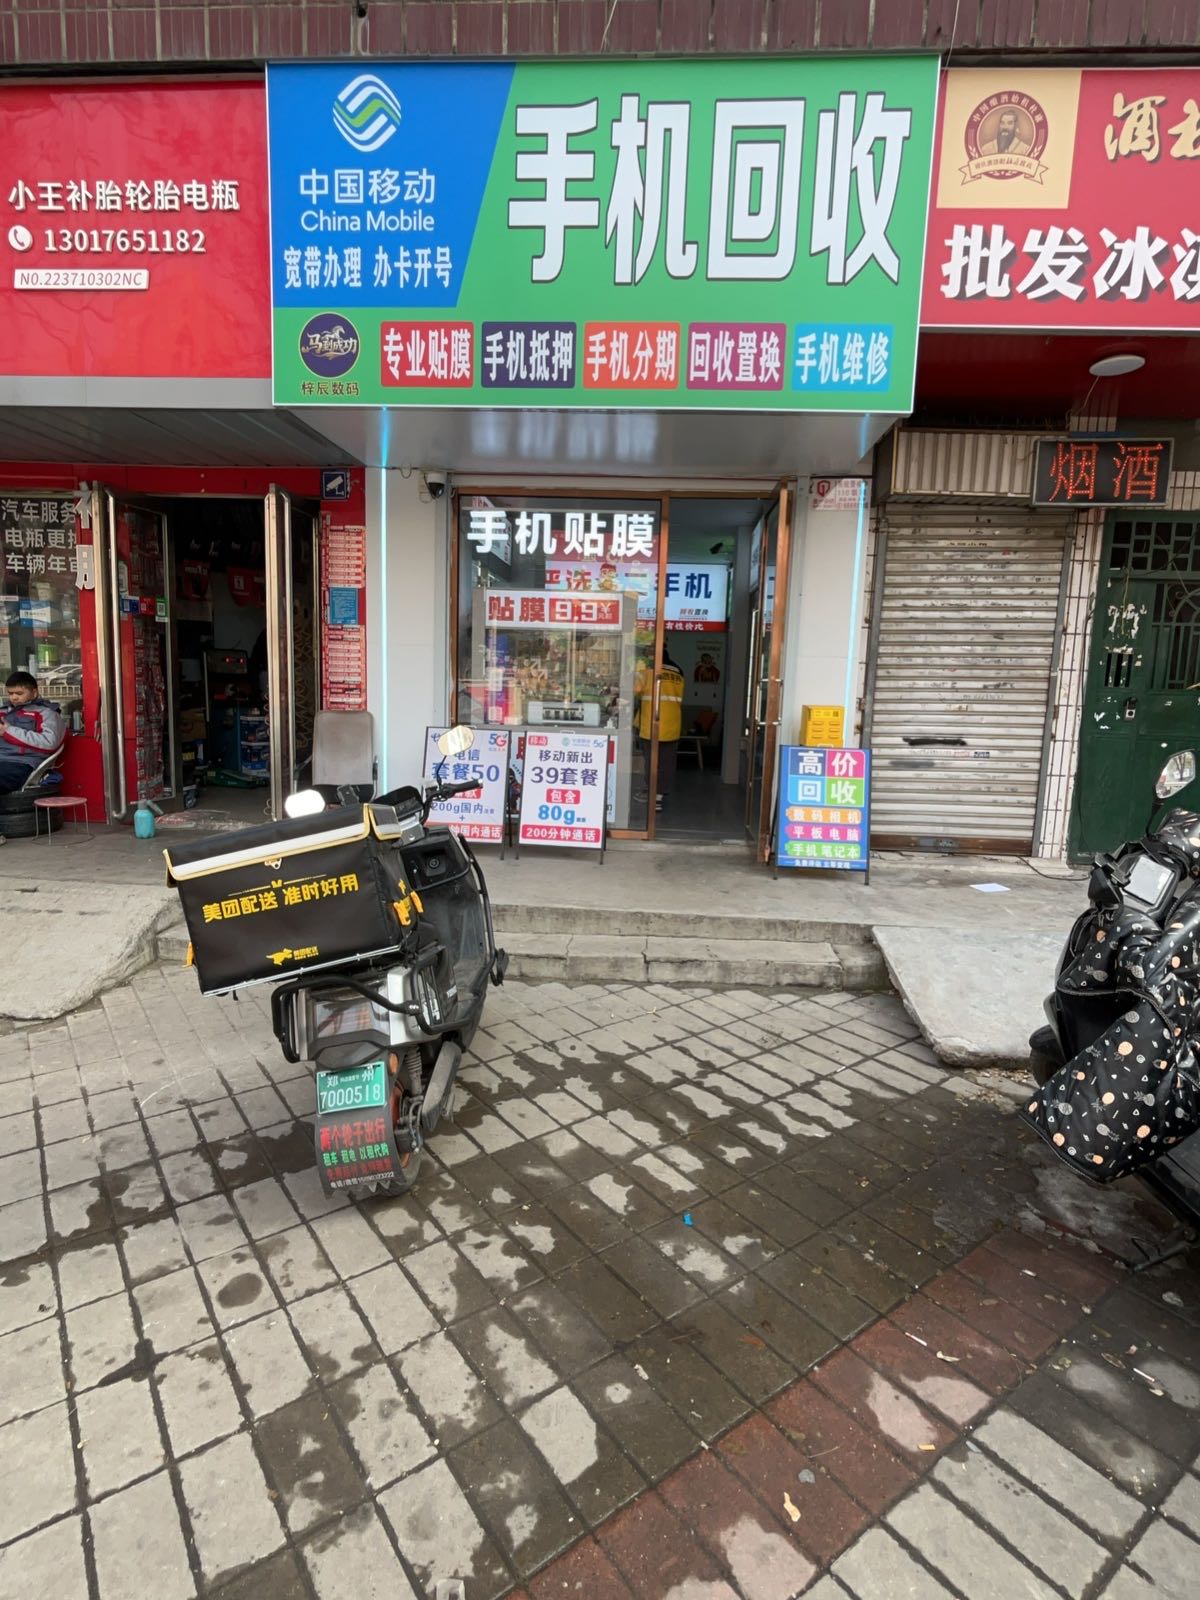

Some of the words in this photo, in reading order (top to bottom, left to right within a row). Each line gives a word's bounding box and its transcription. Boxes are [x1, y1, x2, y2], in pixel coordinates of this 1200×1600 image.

[7, 179, 241, 213] 小王补胎轮胎电瓶
[299, 167, 436, 206] 中国移动
[507, 91, 913, 287] 手机回收
[300, 210, 361, 232] China
[366, 209, 435, 232] Mobile
[44, 228, 207, 254] 13017651182
[19, 271, 143, 287] NO.223710302NC
[283, 245, 363, 290] 宽带办理
[373, 245, 453, 289] 办卡开号
[301, 330, 358, 355] 马到成功
[383, 327, 472, 381] 专业贴膜
[484, 329, 574, 382] 手机抵押
[586, 330, 678, 383] 手机分期
[689, 330, 782, 384] 回收置换
[795, 331, 890, 385] 手机维修
[301, 381, 360, 396] 梓辰数码
[1048, 441, 1164, 502] 烟酒
[1, 498, 76, 524] 汽车服务
[467, 509, 655, 558] 手机贴膜
[488, 595, 545, 623] 贴膜
[489, 733, 508, 748] 5G
[539, 749, 593, 764] 移动新出
[798, 750, 858, 777] 高价
[431, 762, 500, 782] 套餐50
[530, 766, 599, 787] 39套餐
[550, 790, 576, 804] 包含
[798, 780, 857, 804] 回收
[537, 804, 576, 826] 80g
[525, 827, 597, 841] 200分钟通话
[792, 825, 859, 841] 平板电脑
[792, 843, 818, 857] 手机
[821, 845, 859, 859] 笔记本
[202, 892, 279, 925] 美团配送
[283, 872, 360, 906] 准时好用
[326, 1074, 339, 1088] 郑
[361, 1068, 375, 1083] 州
[319, 1083, 382, 1110] 7000518
